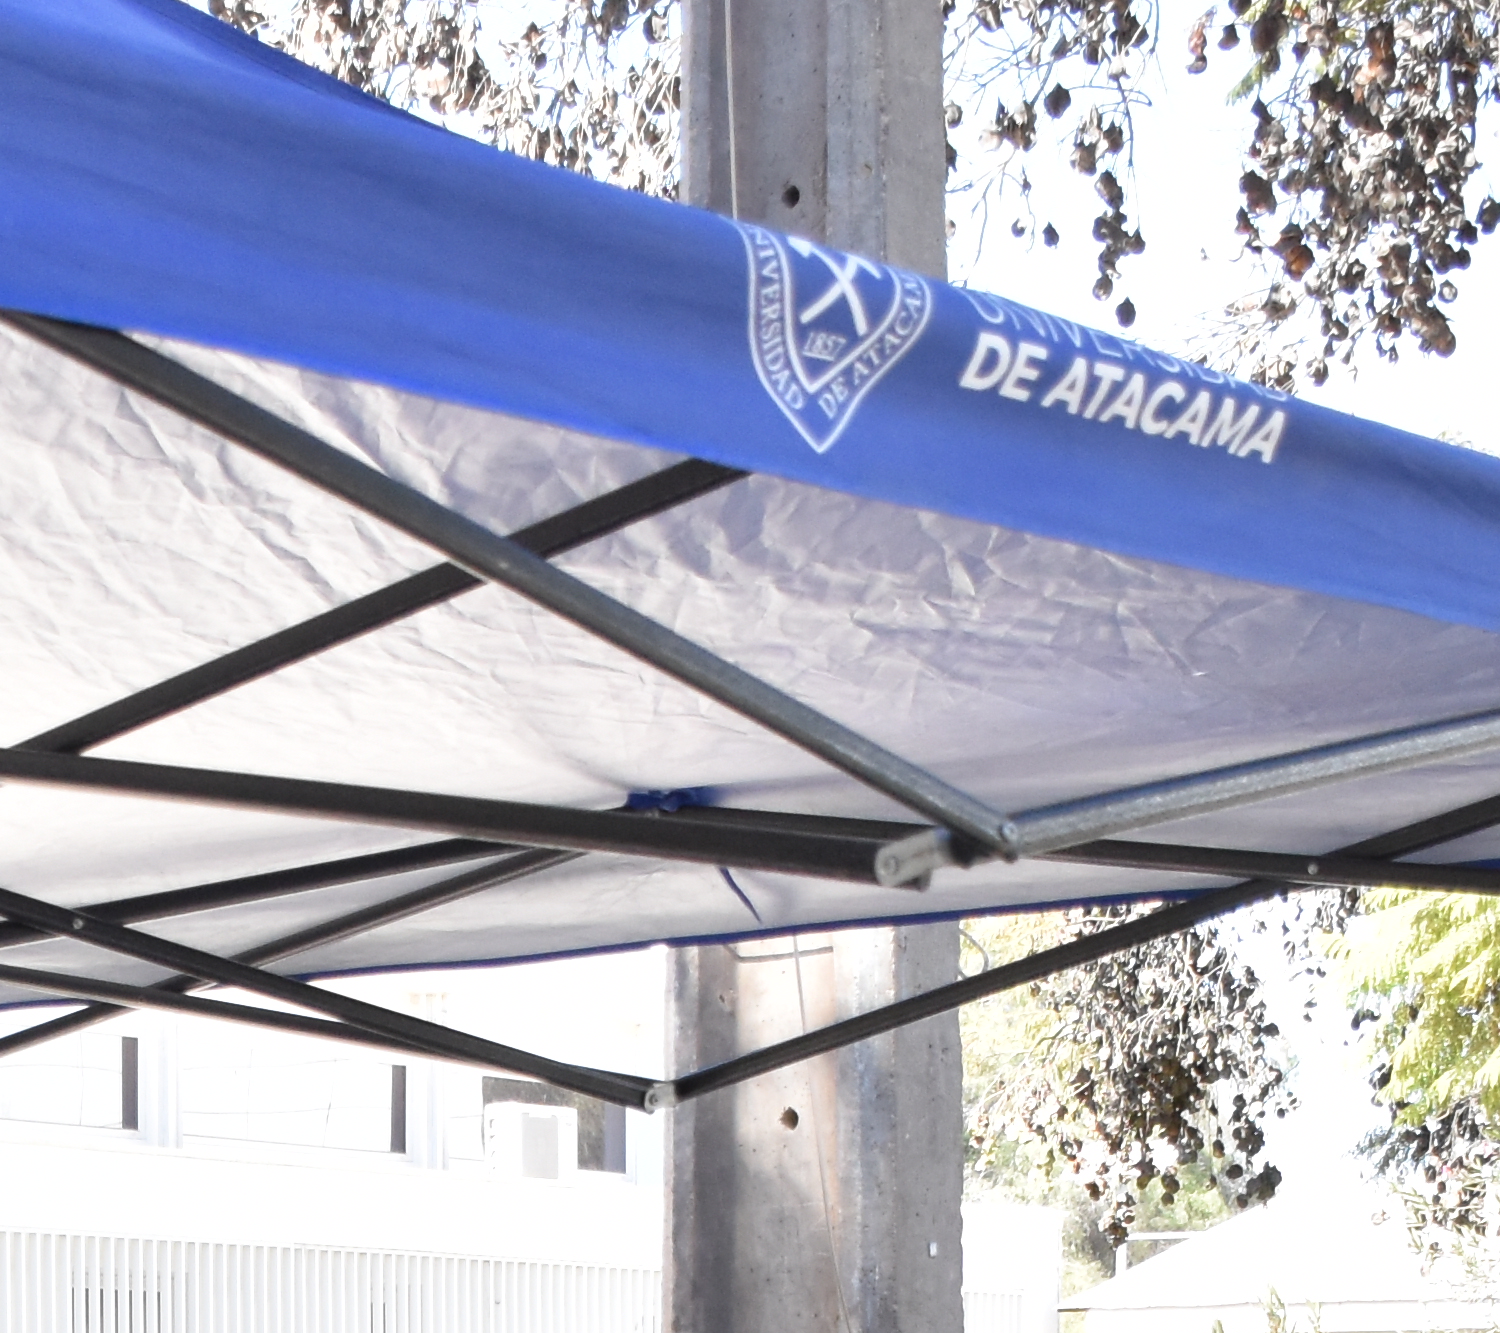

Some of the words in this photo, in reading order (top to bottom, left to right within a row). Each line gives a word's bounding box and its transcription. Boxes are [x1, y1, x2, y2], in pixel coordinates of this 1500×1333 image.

[748, 224, 804, 410] NIVERSIDAD
[818, 377, 849, 420] DE
[852, 274, 923, 386] ATACAM
[958, 331, 1048, 402] DE
[1040, 357, 1287, 464] ATACAMA
